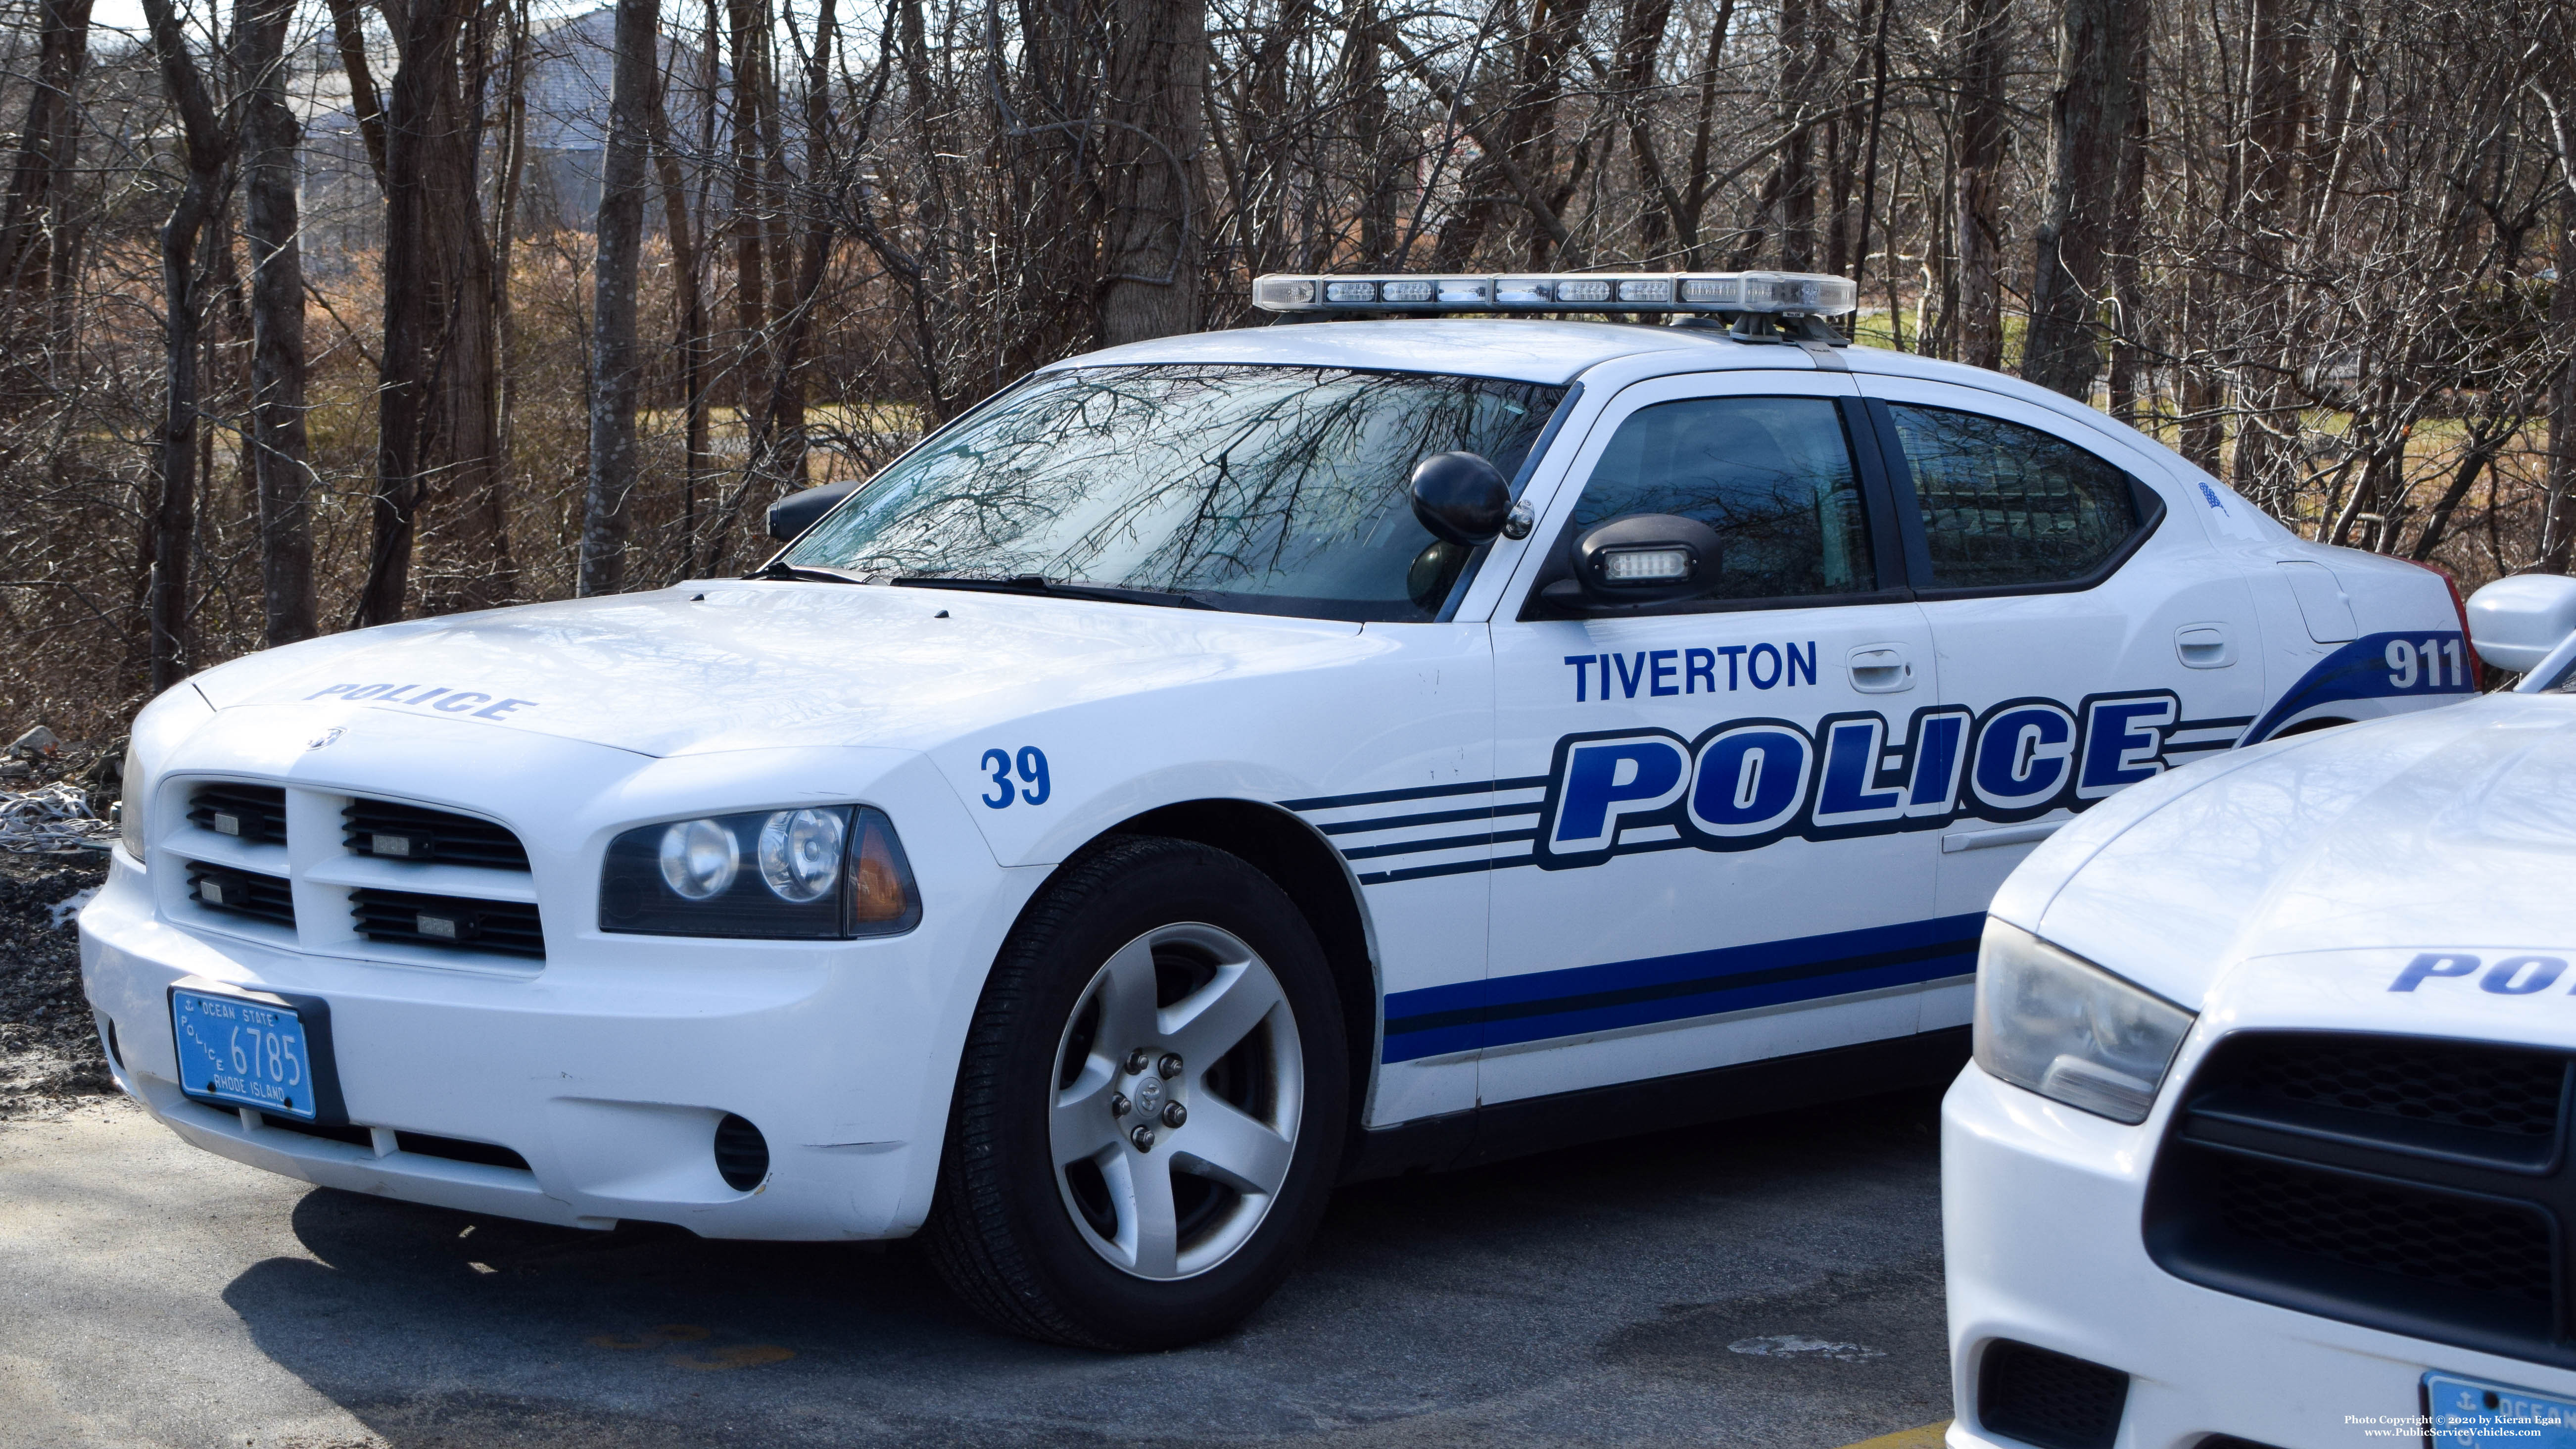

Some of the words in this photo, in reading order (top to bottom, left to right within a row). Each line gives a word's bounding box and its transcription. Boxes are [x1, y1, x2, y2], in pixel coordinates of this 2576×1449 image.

[1564, 641, 1816, 703] TIVERTON
[2385, 639, 2461, 688] 911
[301, 684, 540, 721] POLICE
[981, 745, 1051, 809] 39
[1548, 695, 2177, 855] POLICE
[2387, 953, 2576, 996] PO
[202, 1001, 235, 1020] OCEAN
[243, 1009, 275, 1027] STATE
[181, 1016, 224, 1071] POLICE
[231, 1025, 300, 1086] 6785
[213, 1074, 246, 1094] RHODE
[250, 1082, 285, 1101] ISLAND
